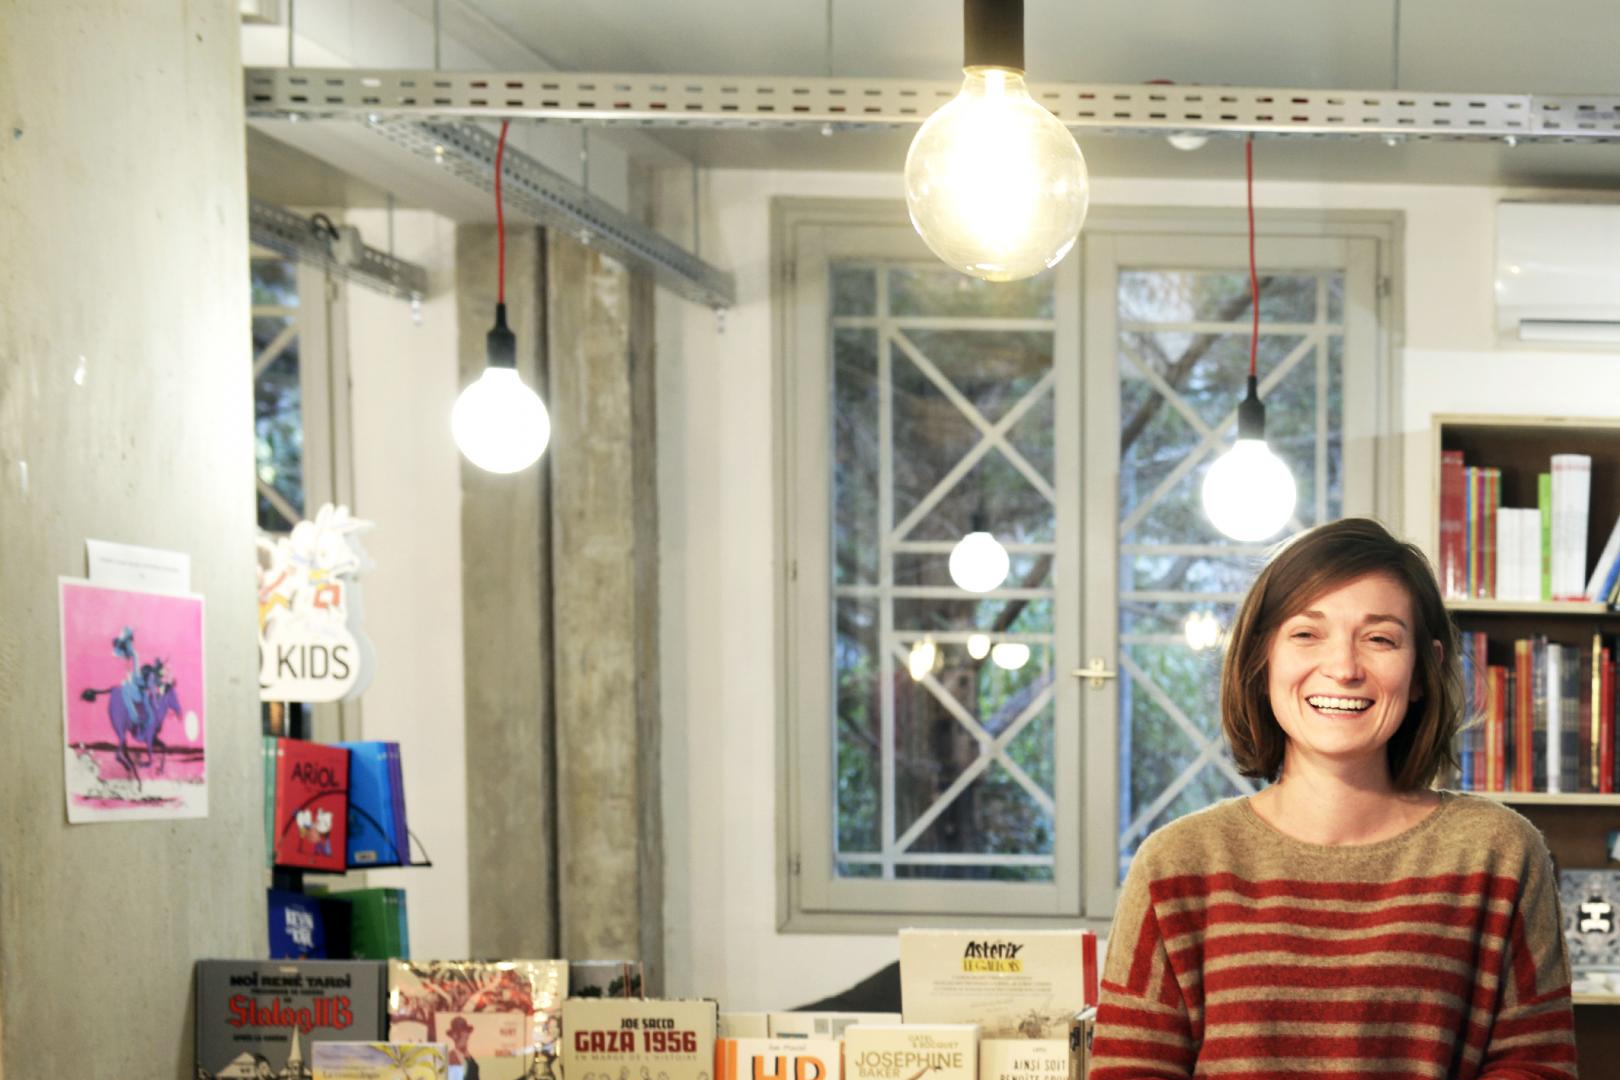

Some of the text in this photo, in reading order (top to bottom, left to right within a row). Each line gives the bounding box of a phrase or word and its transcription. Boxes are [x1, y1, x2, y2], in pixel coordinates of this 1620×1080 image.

[277, 645, 349, 680] KIDS
[620, 1018, 675, 1030] JOE SACCO
[574, 1030, 697, 1053] GAZA 1956
[1013, 1059, 1066, 1071] AINSI SOIT
[858, 1068, 901, 1079] BAKER
